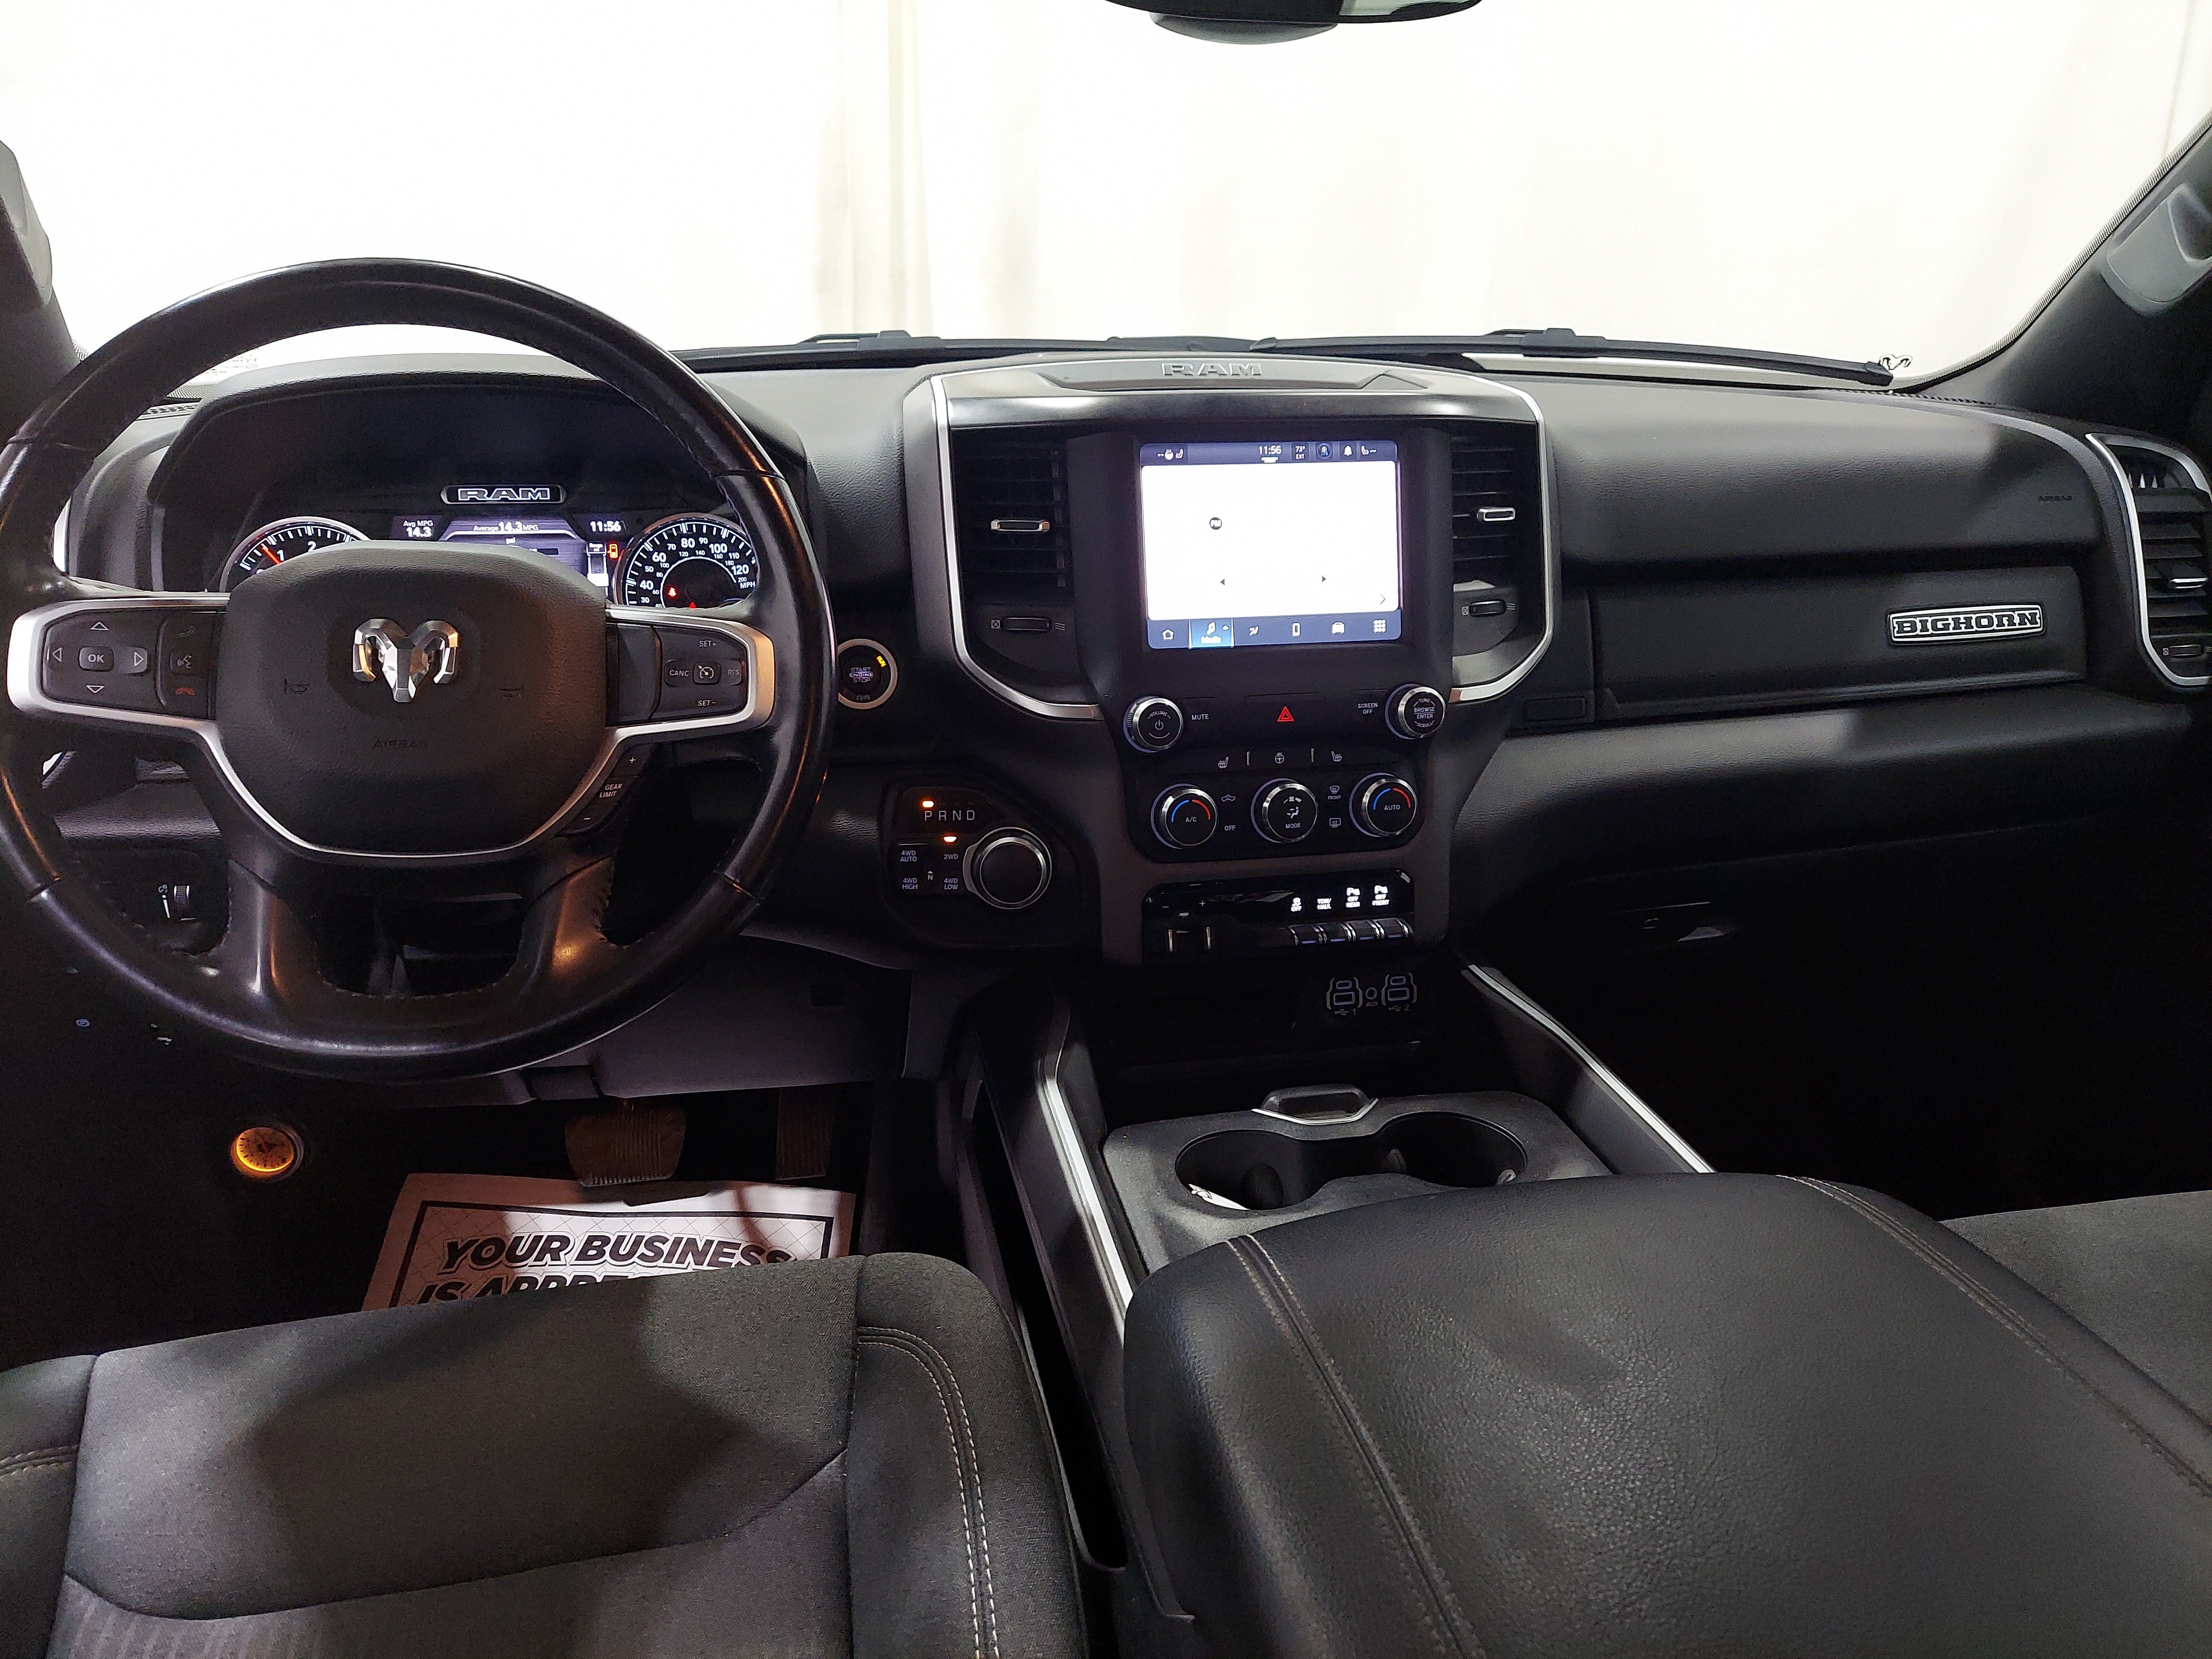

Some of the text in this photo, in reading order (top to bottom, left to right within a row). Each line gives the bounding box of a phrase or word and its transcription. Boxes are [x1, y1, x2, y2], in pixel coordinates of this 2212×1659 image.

[1161, 363, 1262, 376] RAM
[1259, 445, 1282, 455] 11:56
[458, 488, 550, 501] RAM
[498, 521, 523, 532] 14.3
[590, 521, 622, 532] 11:56
[406, 527, 432, 538] 14.3
[681, 538, 695, 548] 80
[709, 543, 728, 554] 100
[277, 550, 284, 561] 1
[652, 552, 666, 563] 60
[731, 564, 749, 575] 120
[640, 580, 654, 590] 40
[740, 581, 756, 589] MPH
[1893, 610, 2041, 637] BIGHORN
[88, 654, 104, 663] OK
[924, 810, 932, 821] P
[966, 810, 975, 821] D
[439, 1233, 573, 1272] YOUR
